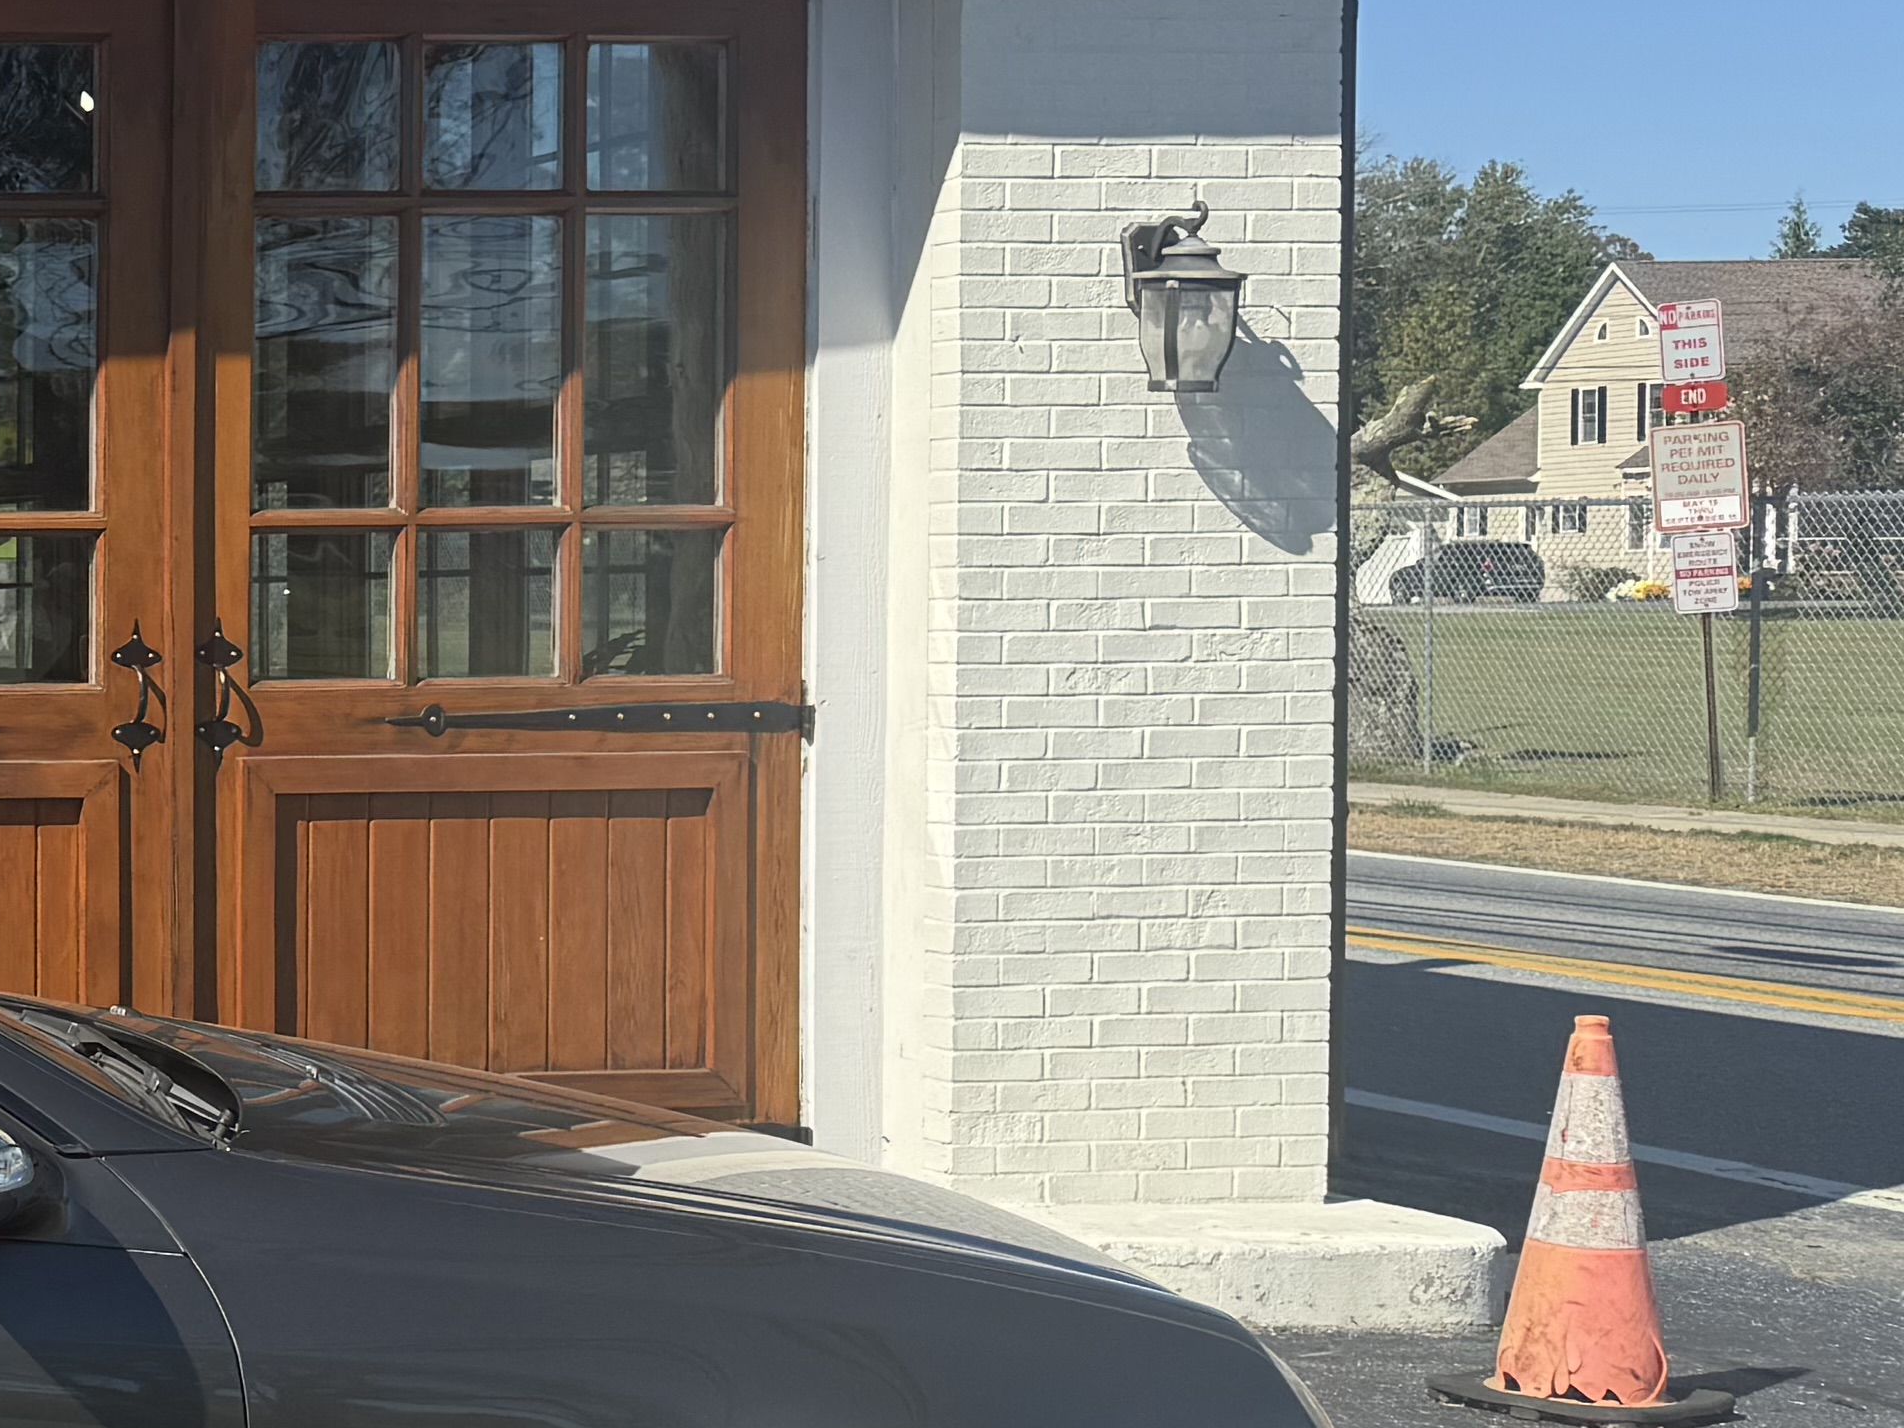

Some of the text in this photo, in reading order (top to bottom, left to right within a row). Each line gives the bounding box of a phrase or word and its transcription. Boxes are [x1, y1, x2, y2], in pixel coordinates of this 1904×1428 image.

[1658, 309, 1715, 325] NO PARKING
[1673, 337, 1707, 350] THIS
[1674, 356, 1710, 369] SIDE
[1680, 388, 1707, 404] END
[1663, 431, 1729, 445] PARKING
[1661, 458, 1735, 472] REQUIRED
[1678, 472, 1719, 485] DAILY
[1665, 514, 1724, 525] SEPTEBER
